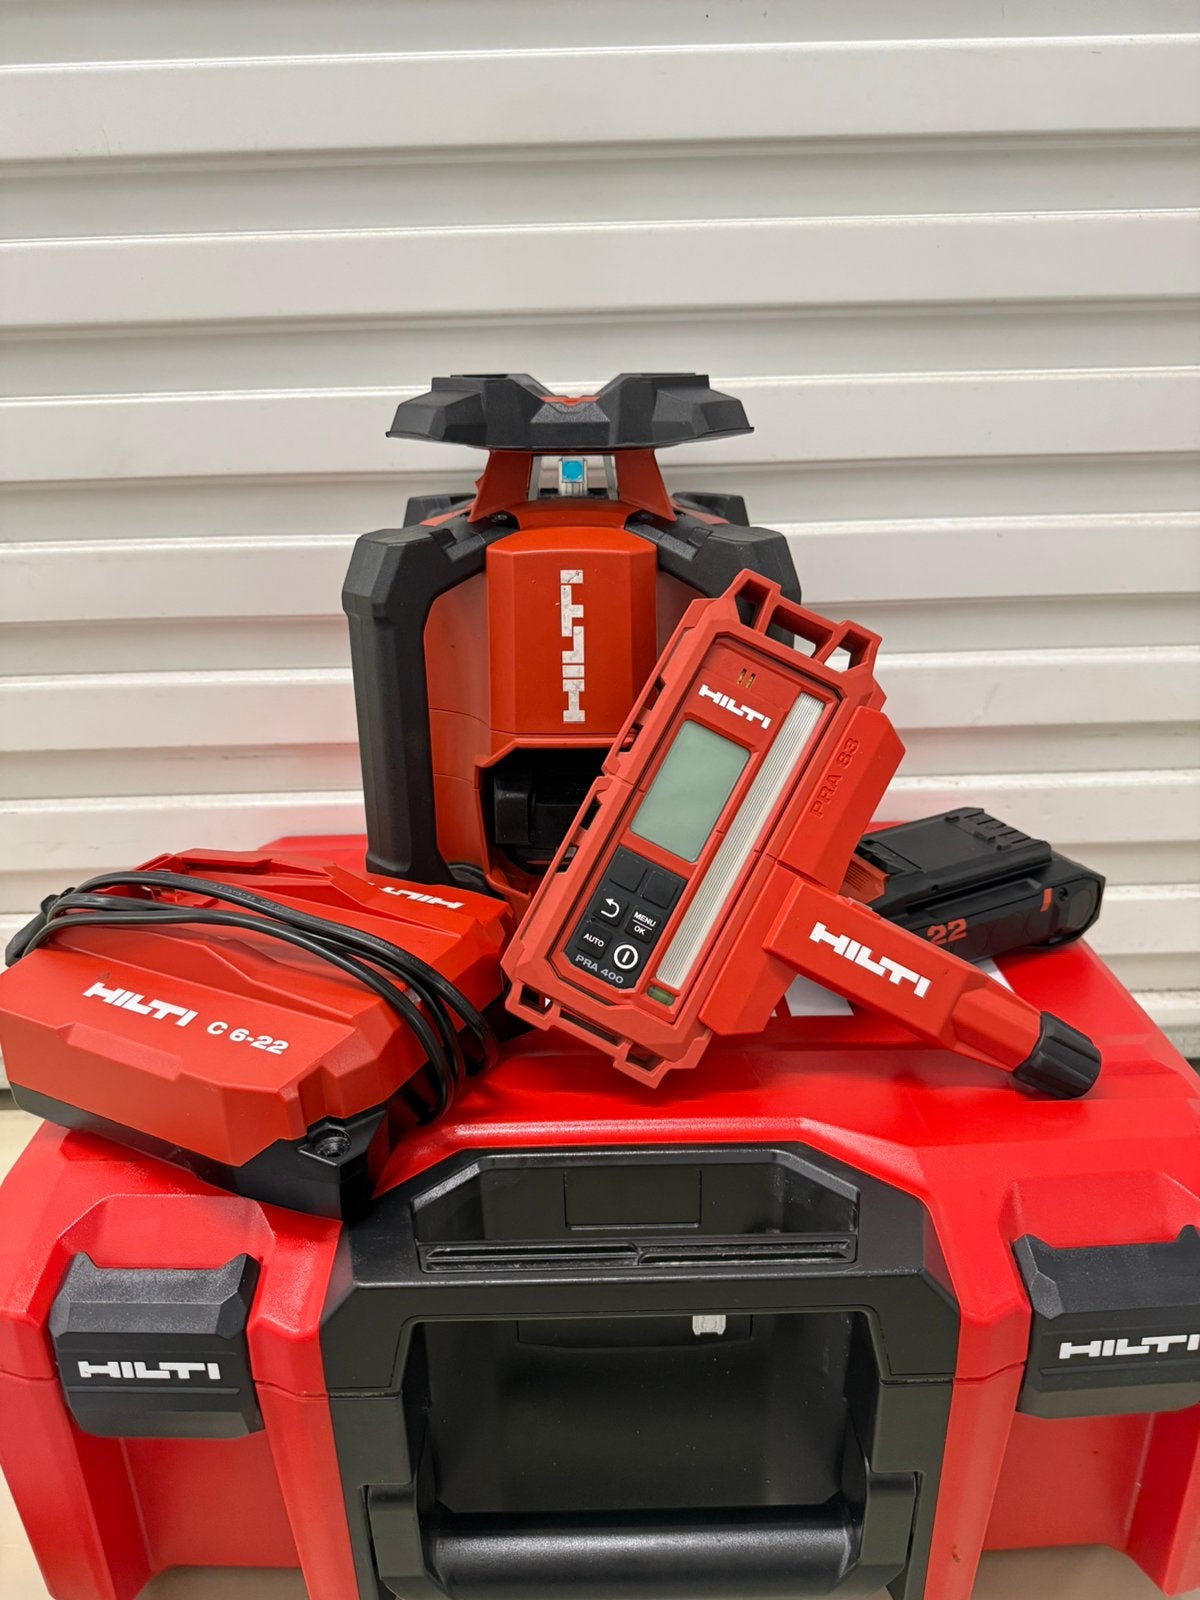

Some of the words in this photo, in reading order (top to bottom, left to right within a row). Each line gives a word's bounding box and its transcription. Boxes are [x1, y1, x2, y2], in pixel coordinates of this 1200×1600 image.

[560, 569, 585, 723] HILTI
[698, 684, 772, 730] HILTI
[809, 774, 842, 818] PRA
[836, 737, 860, 769] 83
[367, 881, 465, 909] HILT
[633, 911, 656, 927] MENU
[633, 924, 647, 936] OK
[583, 933, 605, 947] AUTO
[575, 954, 599, 972] PRA
[600, 968, 624, 984] 400
[809, 921, 932, 998] HILTI
[82, 981, 199, 1028] HILTI
[206, 1021, 229, 1036] C
[229, 1028, 290, 1056] 6-22
[1058, 1333, 1200, 1360] HILTI
[77, 1360, 221, 1380] HILTI
